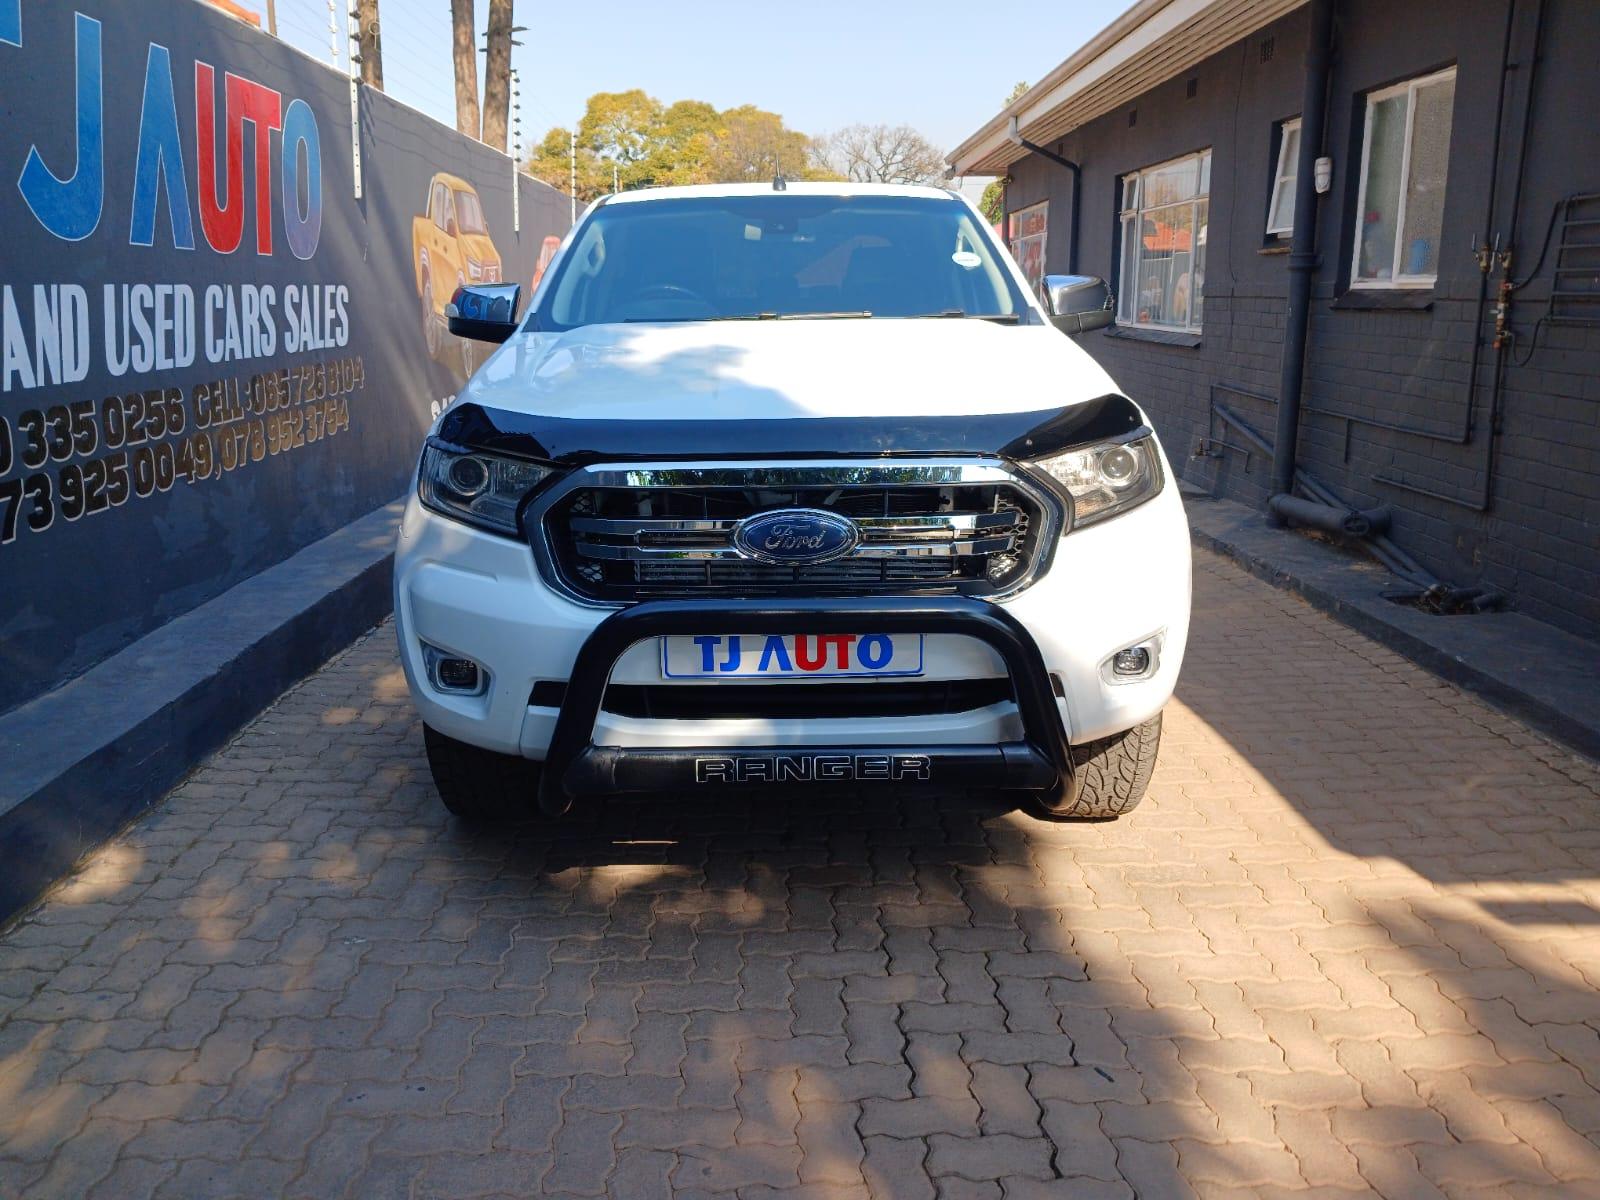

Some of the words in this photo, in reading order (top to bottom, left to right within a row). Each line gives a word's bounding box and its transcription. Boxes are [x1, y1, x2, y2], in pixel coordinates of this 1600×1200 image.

[0, 0, 104, 242] J
[129, 41, 322, 260] AUTO
[2, 284, 90, 392] AND
[103, 283, 196, 376] USED
[204, 284, 277, 363] CARS
[284, 284, 349, 353] SALES
[18, 400, 99, 469] 335
[102, 387, 186, 449] 0256
[59, 452, 131, 521] 925
[764, 523, 827, 550] Ford
[694, 635, 741, 672] TJ
[757, 634, 894, 671] AUTO
[695, 755, 931, 783] RANGER
